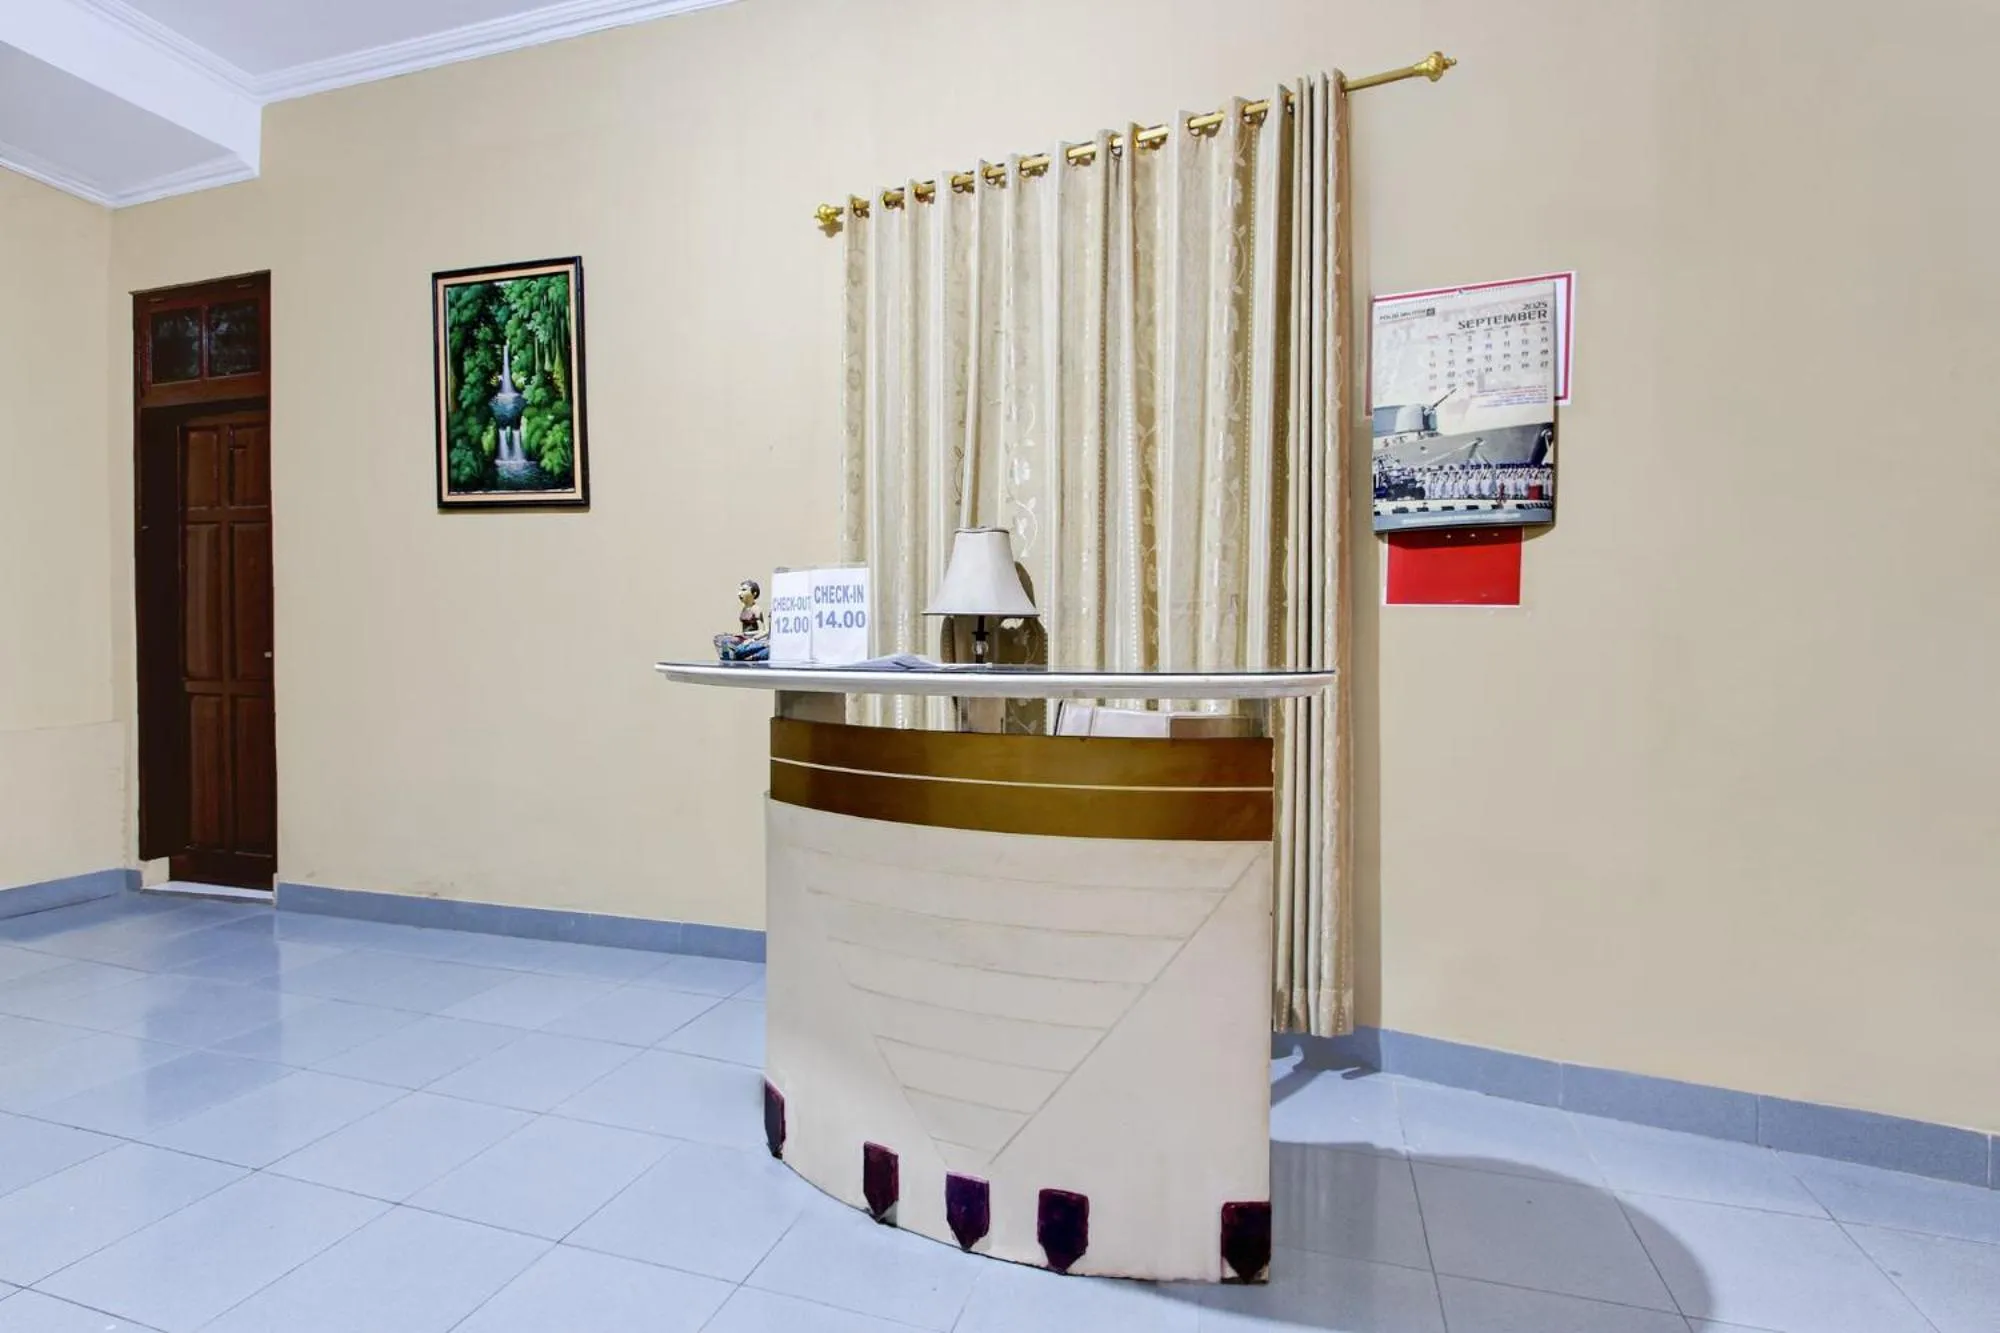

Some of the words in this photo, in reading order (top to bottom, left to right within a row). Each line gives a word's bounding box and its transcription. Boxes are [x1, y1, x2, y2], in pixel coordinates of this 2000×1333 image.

[1523, 301, 1548, 311] 2025
[1458, 309, 1548, 330] SEPTEMBER
[814, 584, 864, 604] CHECK-IN
[773, 596, 811, 612] CHECK-OUT
[775, 616, 809, 634] 12.00
[815, 610, 866, 628] 14.00
